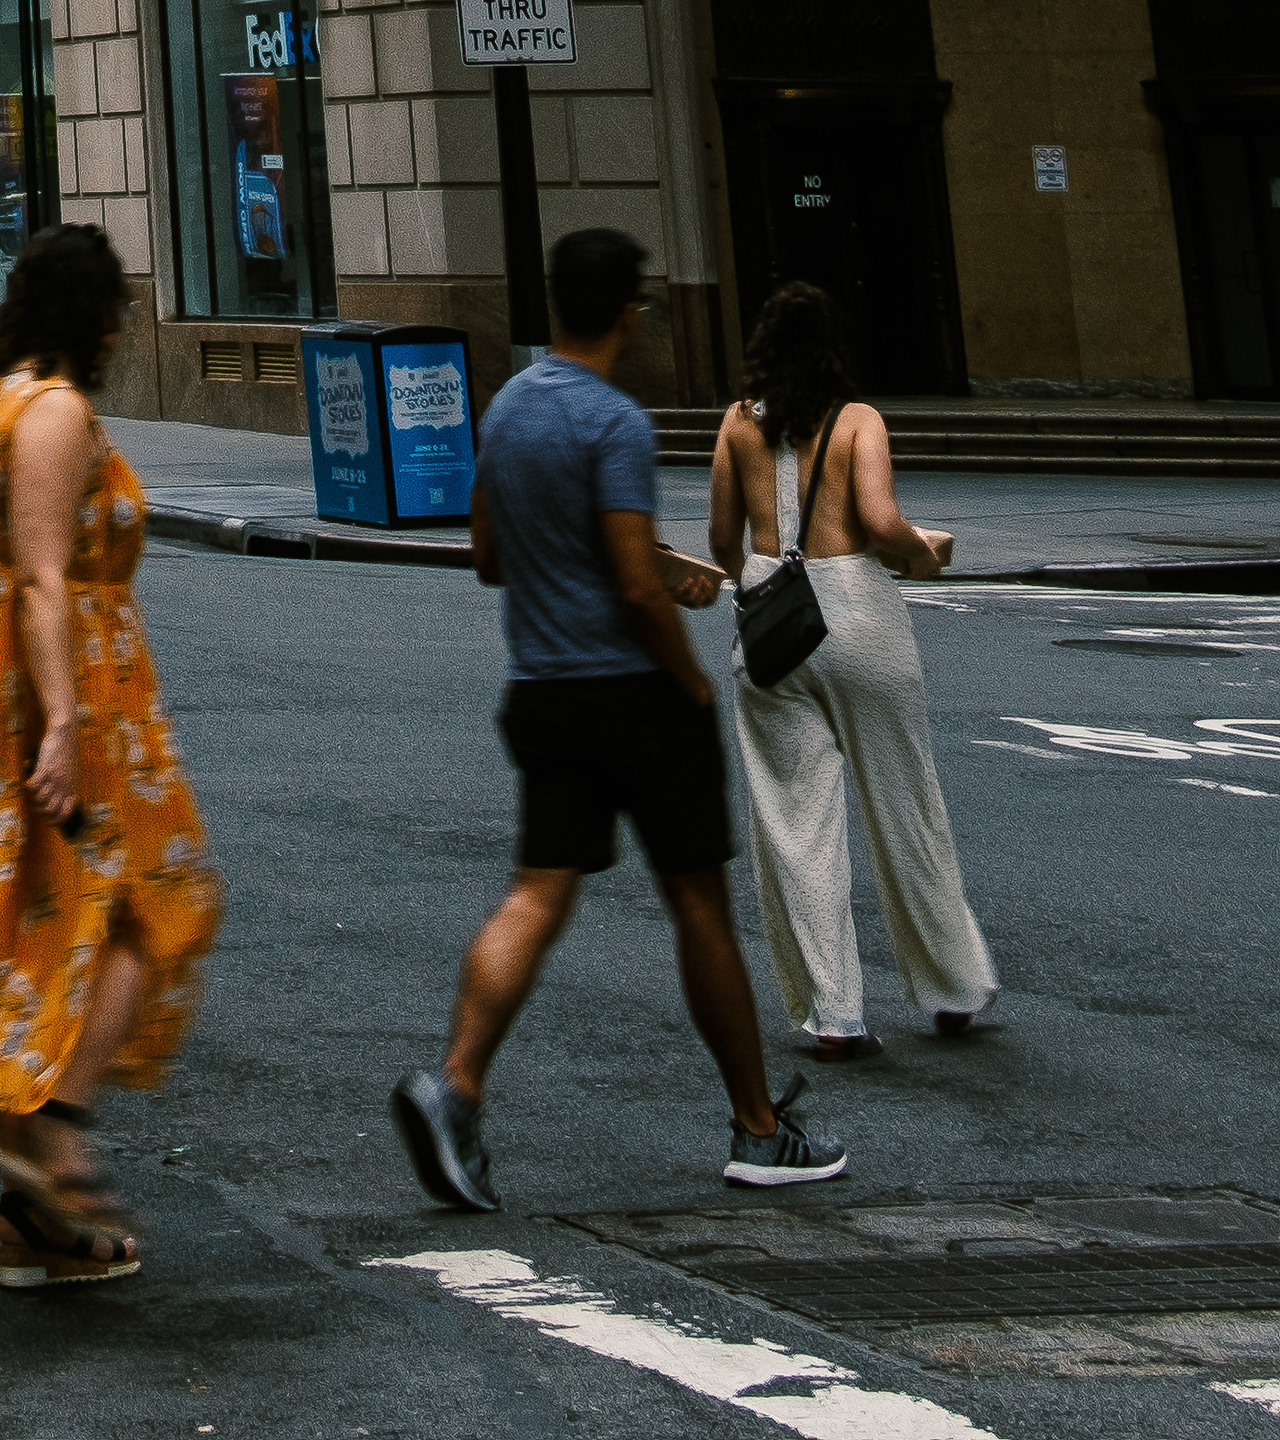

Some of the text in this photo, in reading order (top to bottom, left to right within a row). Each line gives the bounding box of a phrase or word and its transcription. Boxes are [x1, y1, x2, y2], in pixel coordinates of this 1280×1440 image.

[245, 11, 315, 69] FedEx
[469, 27, 567, 51] TRAFFIC
[804, 175, 821, 188] NO
[794, 194, 831, 207] ENTRY
[392, 380, 460, 400] DOWNTOWN
[405, 394, 456, 410] STORIES
